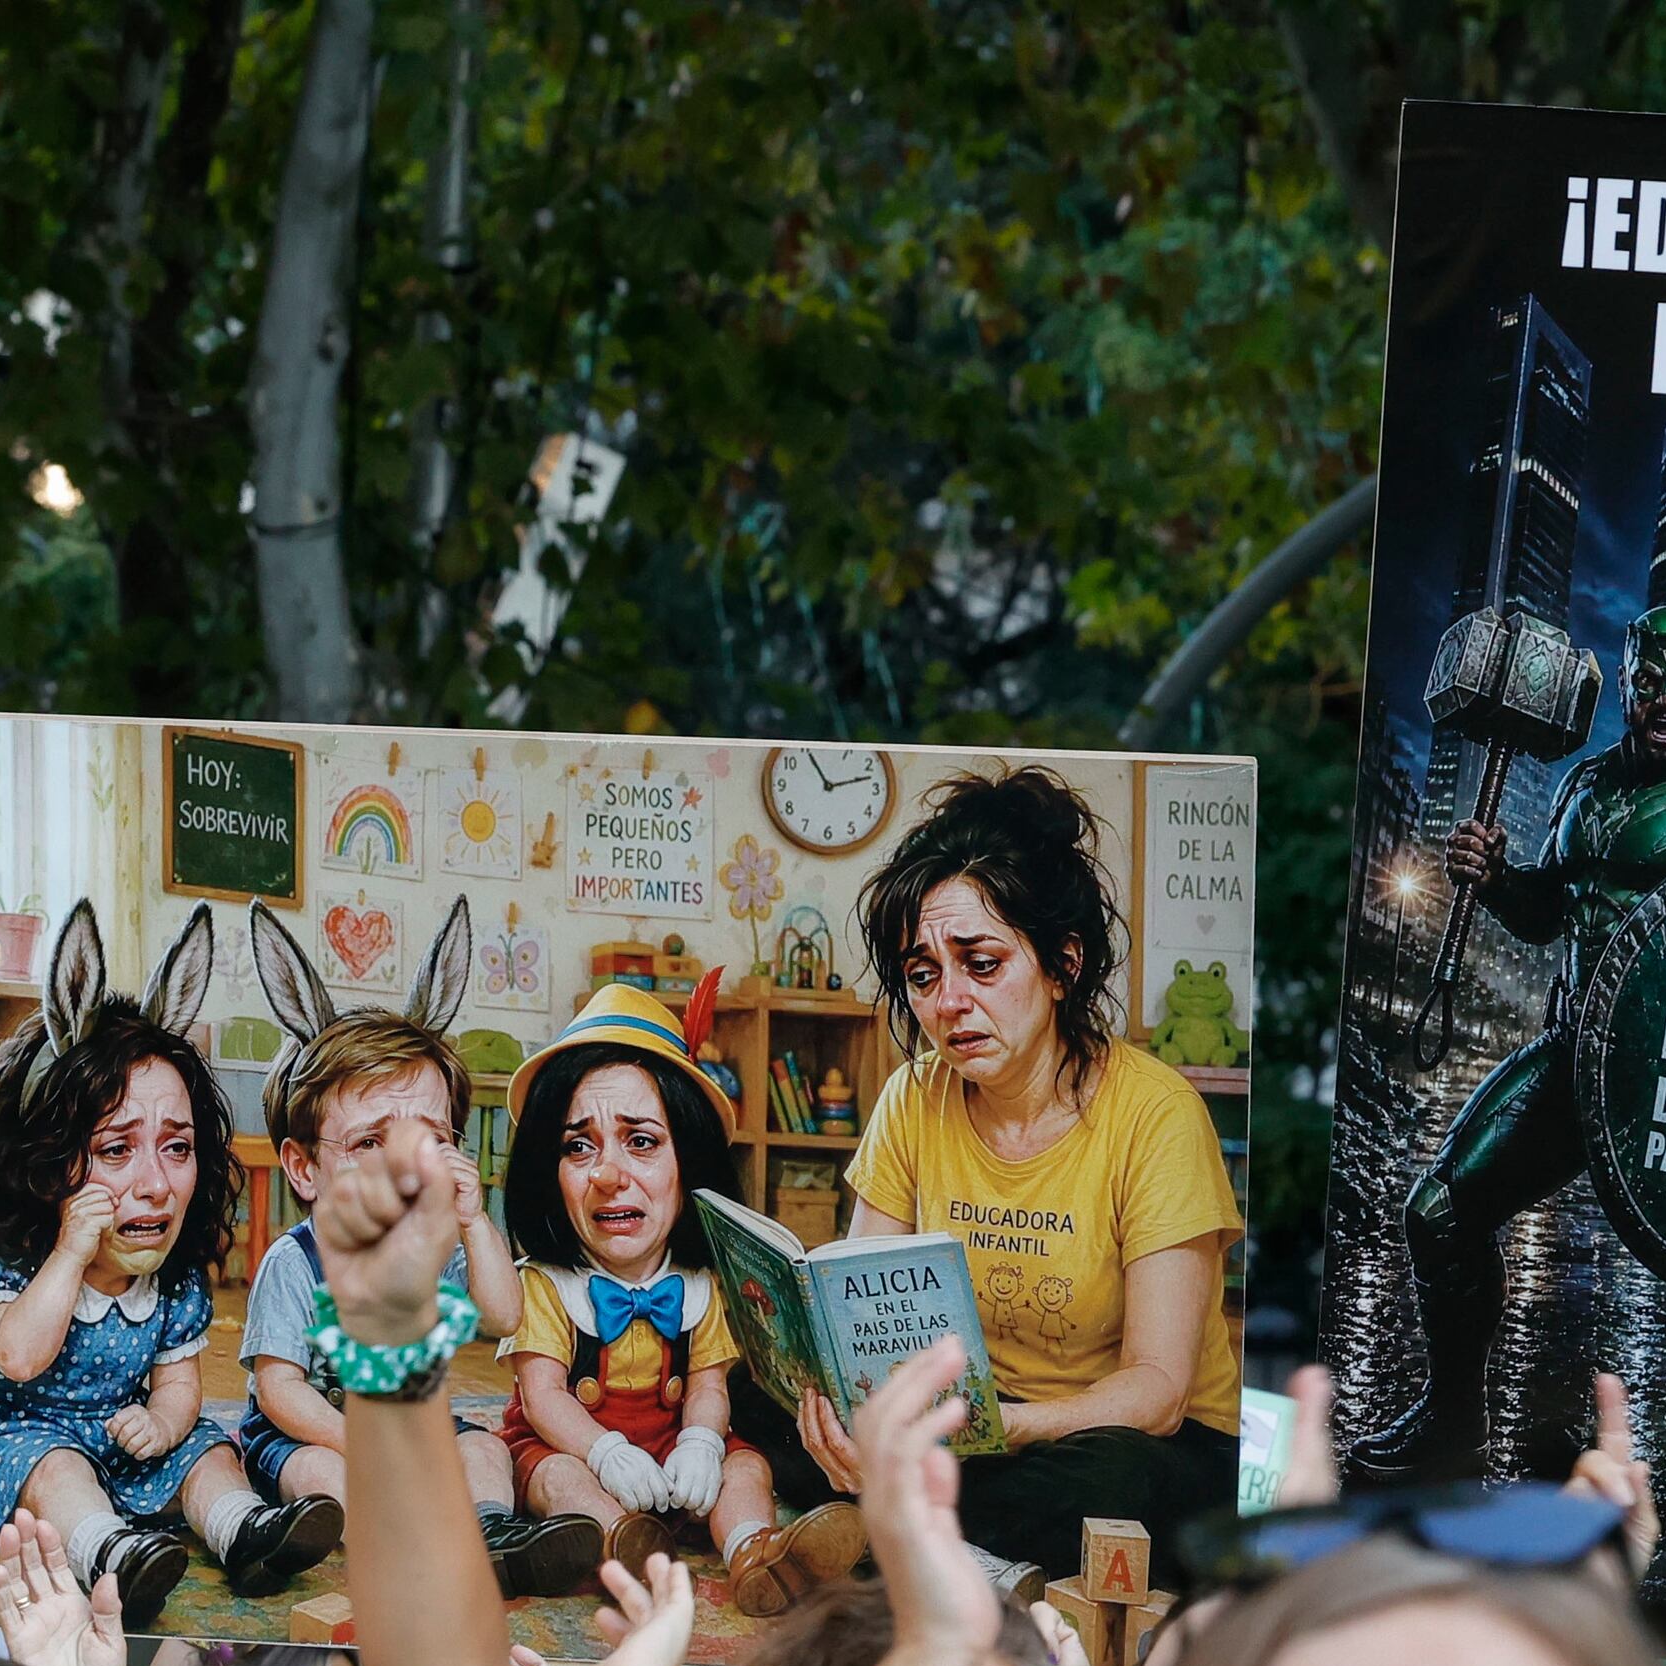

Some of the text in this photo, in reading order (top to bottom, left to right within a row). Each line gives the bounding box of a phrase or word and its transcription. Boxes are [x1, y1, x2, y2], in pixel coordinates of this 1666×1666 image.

[187, 753, 241, 792] HOY:
[783, 756, 797, 771] 10
[864, 757, 874, 772] 2
[604, 782, 673, 810] SOMOS
[777, 778, 787, 792] 9
[871, 782, 880, 796] 3
[784, 801, 794, 815] 8
[863, 804, 873, 819] 4
[585, 812, 692, 843] PEQUEÑOS
[801, 818, 809, 832] 7
[823, 825, 833, 840] 6
[846, 821, 856, 835] 5
[611, 846, 663, 870] PERO
[1178, 839, 1235, 862] DE LA
[575, 874, 704, 905] IMPORTANTES
[1165, 873, 1243, 902] CALMA
[949, 1200, 1075, 1235] EDUCADORA
[968, 1230, 1050, 1257] INFANTIL
[844, 1266, 943, 1300] ALICIA
[875, 1299, 918, 1316] EN EL
[853, 1313, 949, 1338] PAIS DE LAS
[1101, 1548, 1135, 1593] A
